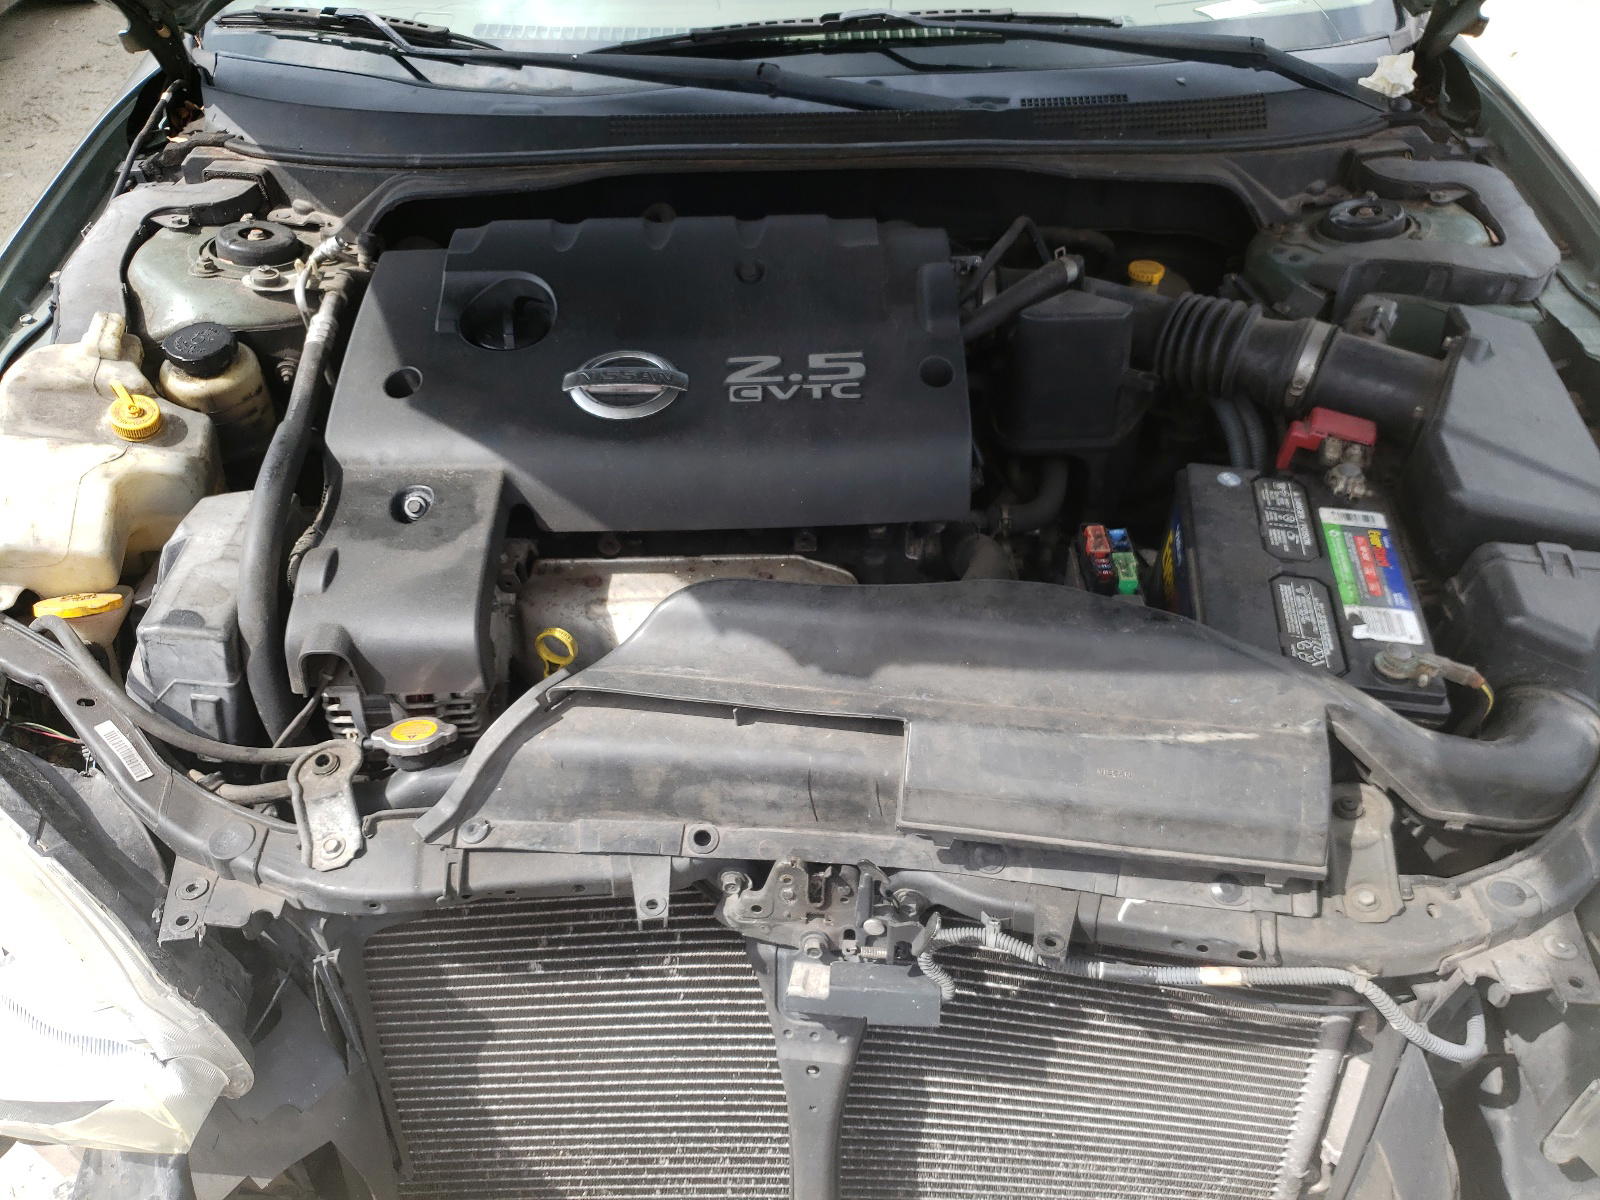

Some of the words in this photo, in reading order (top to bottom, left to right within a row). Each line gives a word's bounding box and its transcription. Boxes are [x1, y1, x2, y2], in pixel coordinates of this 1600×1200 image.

[577, 368, 673, 383] NISSAN
[724, 351, 866, 383] 2.5
[729, 382, 861, 402] CVTC
